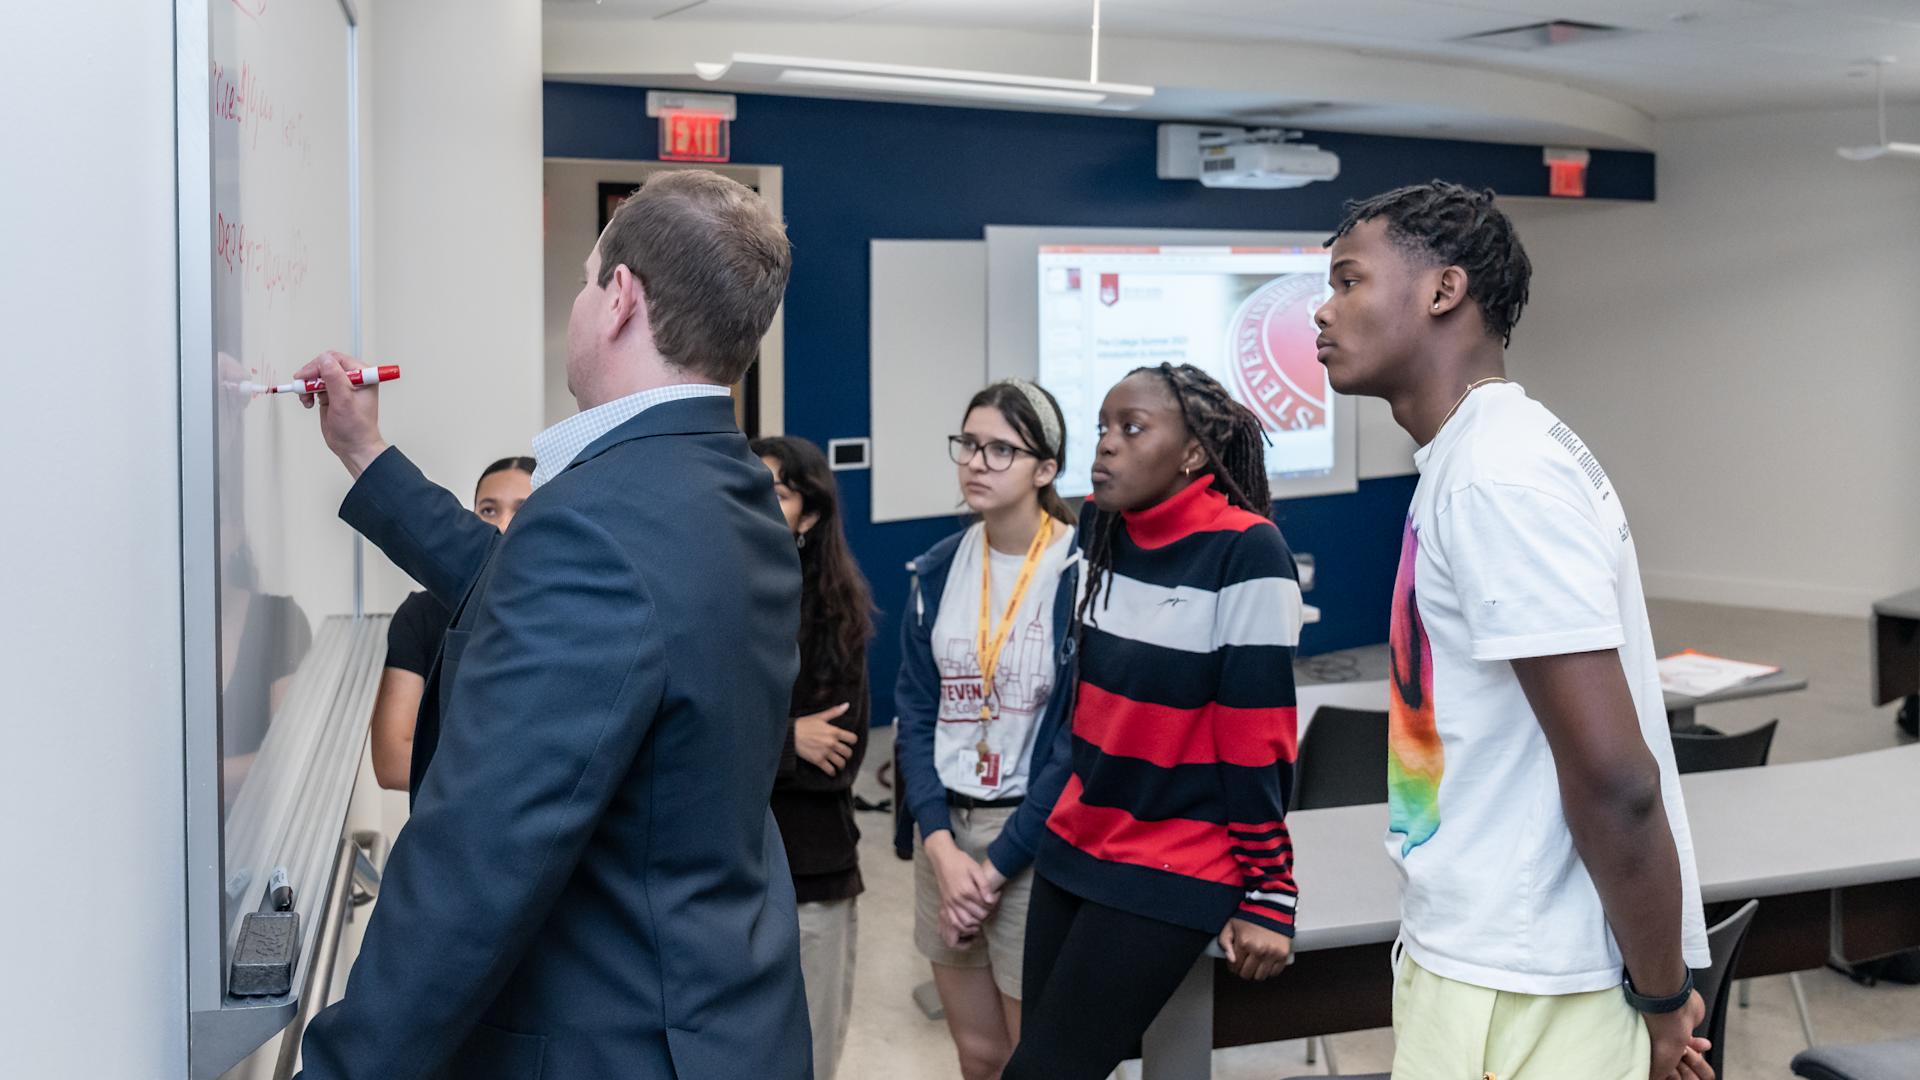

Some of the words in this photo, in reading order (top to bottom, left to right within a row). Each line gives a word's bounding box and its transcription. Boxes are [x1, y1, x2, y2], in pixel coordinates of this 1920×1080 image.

[670, 115, 721, 156] EXIT
[1240, 323, 1315, 431] STEVENS
[941, 683, 992, 701] TEVEN
